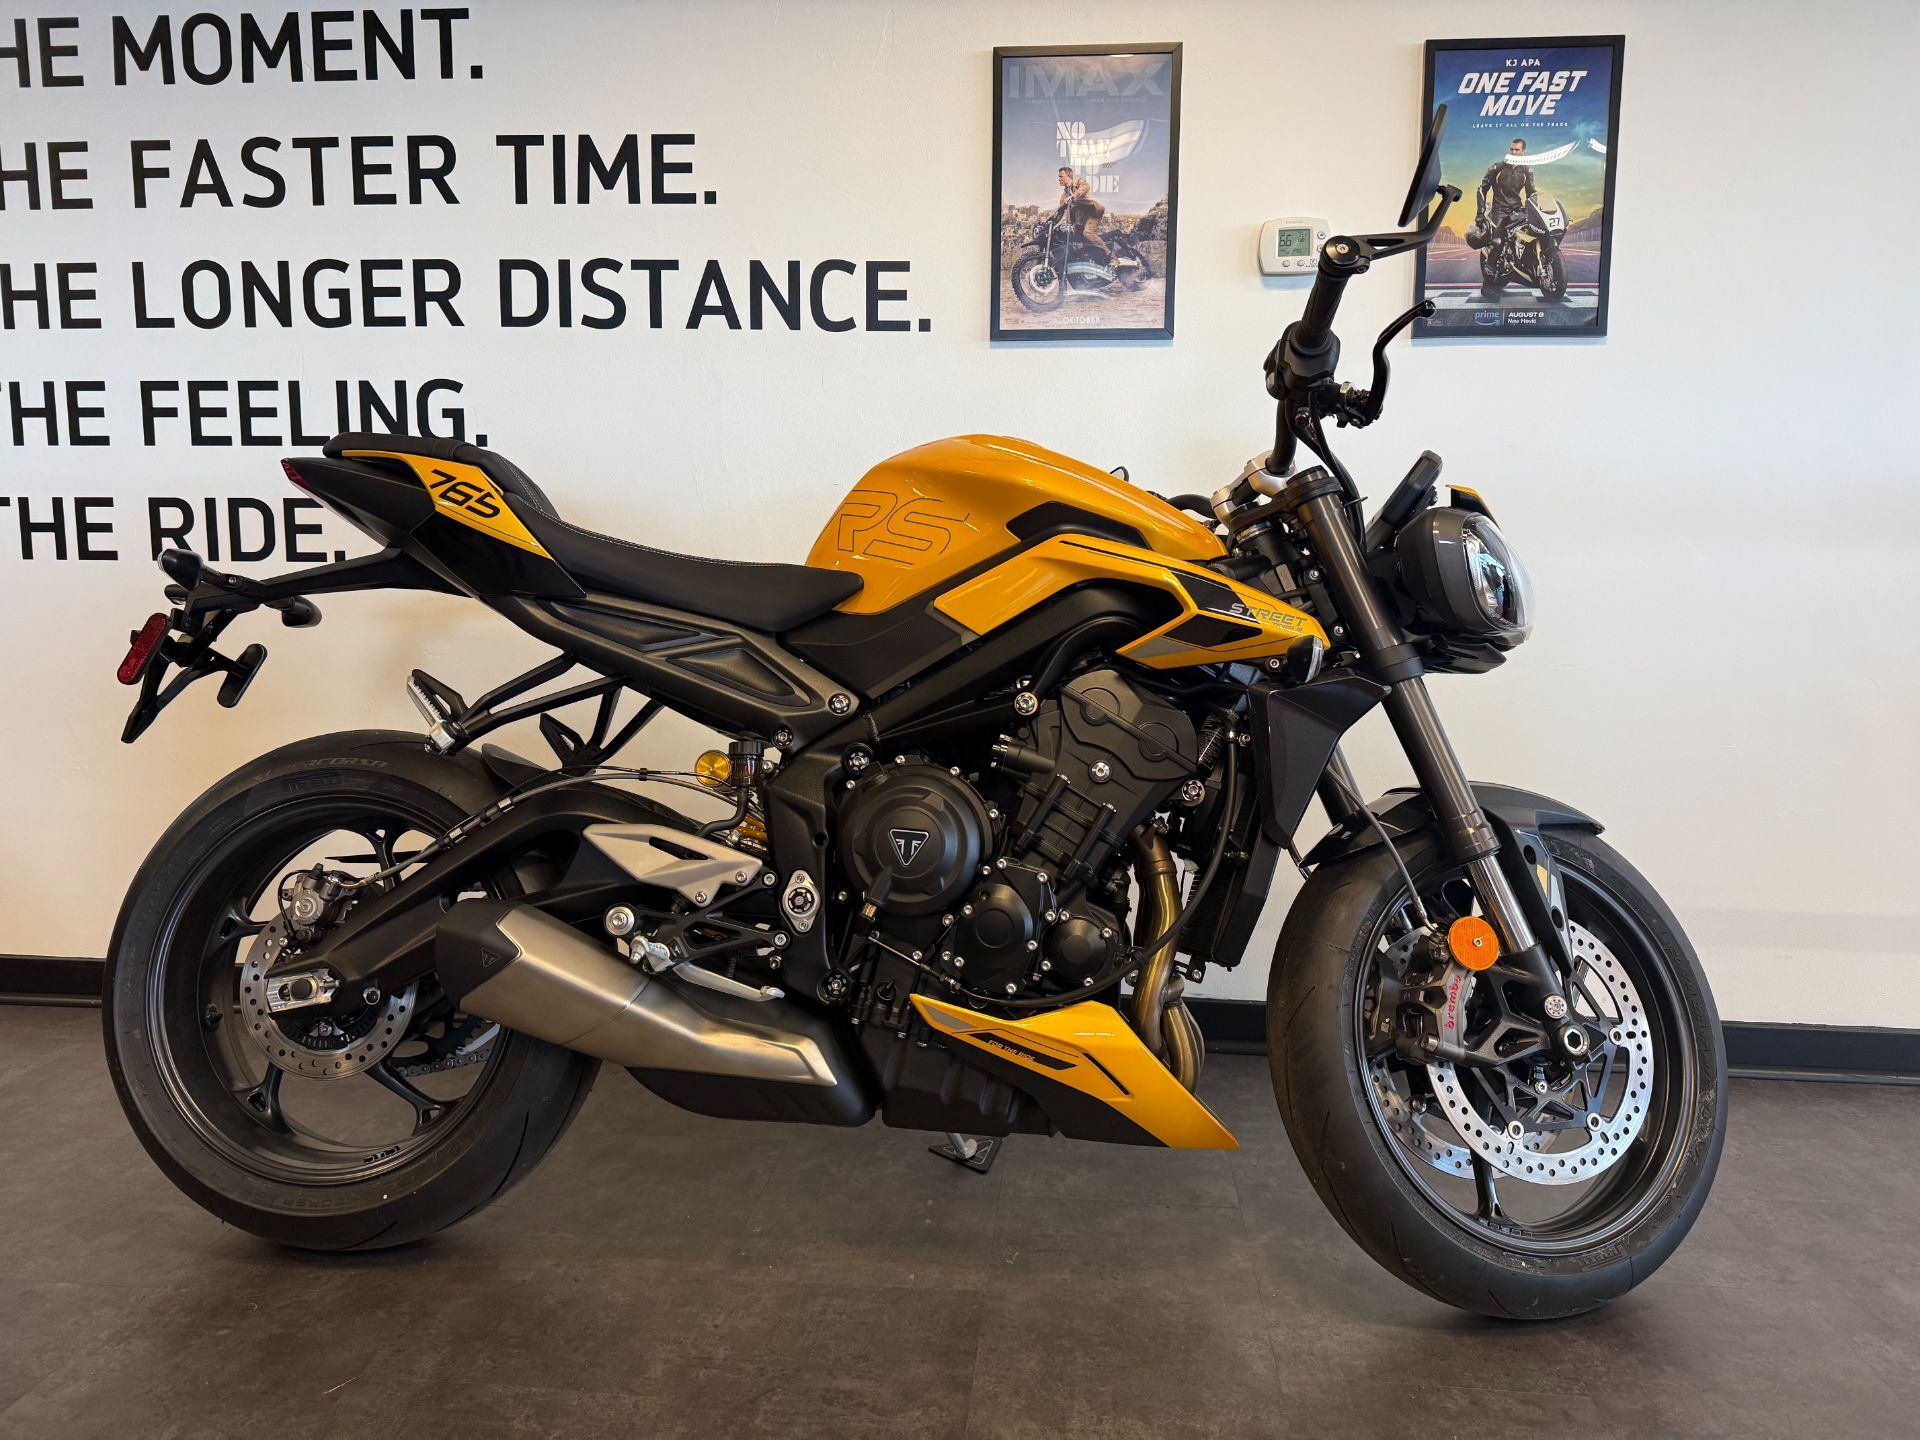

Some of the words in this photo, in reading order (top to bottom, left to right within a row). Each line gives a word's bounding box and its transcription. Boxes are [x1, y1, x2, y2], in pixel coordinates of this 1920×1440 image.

[111, 8, 484, 86] MOMENT.
[1505, 59, 1518, 67] KJ
[1521, 58, 1541, 67] APA
[1008, 62, 1165, 98] IMAX
[1458, 71, 1516, 94] ONE
[1516, 70, 1588, 93] FAST
[1479, 93, 1563, 117] MOVE
[1056, 121, 1086, 140] NO
[1055, 139, 1110, 158] TIME
[130, 136, 461, 209] FASTER
[495, 133, 717, 205] TIME.
[1070, 157, 1100, 175] TO
[1085, 175, 1120, 193] DIE
[1548, 217, 1560, 228] 27
[1279, 234, 1292, 247] 66
[0, 261, 102, 330] HE
[131, 258, 465, 330] LONGER
[498, 257, 931, 333] DISTANCE.
[1474, 310, 1500, 320] prime
[0, 380, 110, 447] HE
[139, 378, 488, 447] FEELING.
[429, 468, 501, 519] 765
[0, 496, 119, 561] HE
[148, 496, 346, 563] RIDE.
[837, 489, 970, 566] RS
[1230, 602, 1308, 627] STREET
[1444, 975, 1462, 1030] brembo
[988, 1039, 1004, 1049] FOR
[1004, 1045, 1018, 1055] THE
[1018, 1051, 1037, 1061] RIDE
